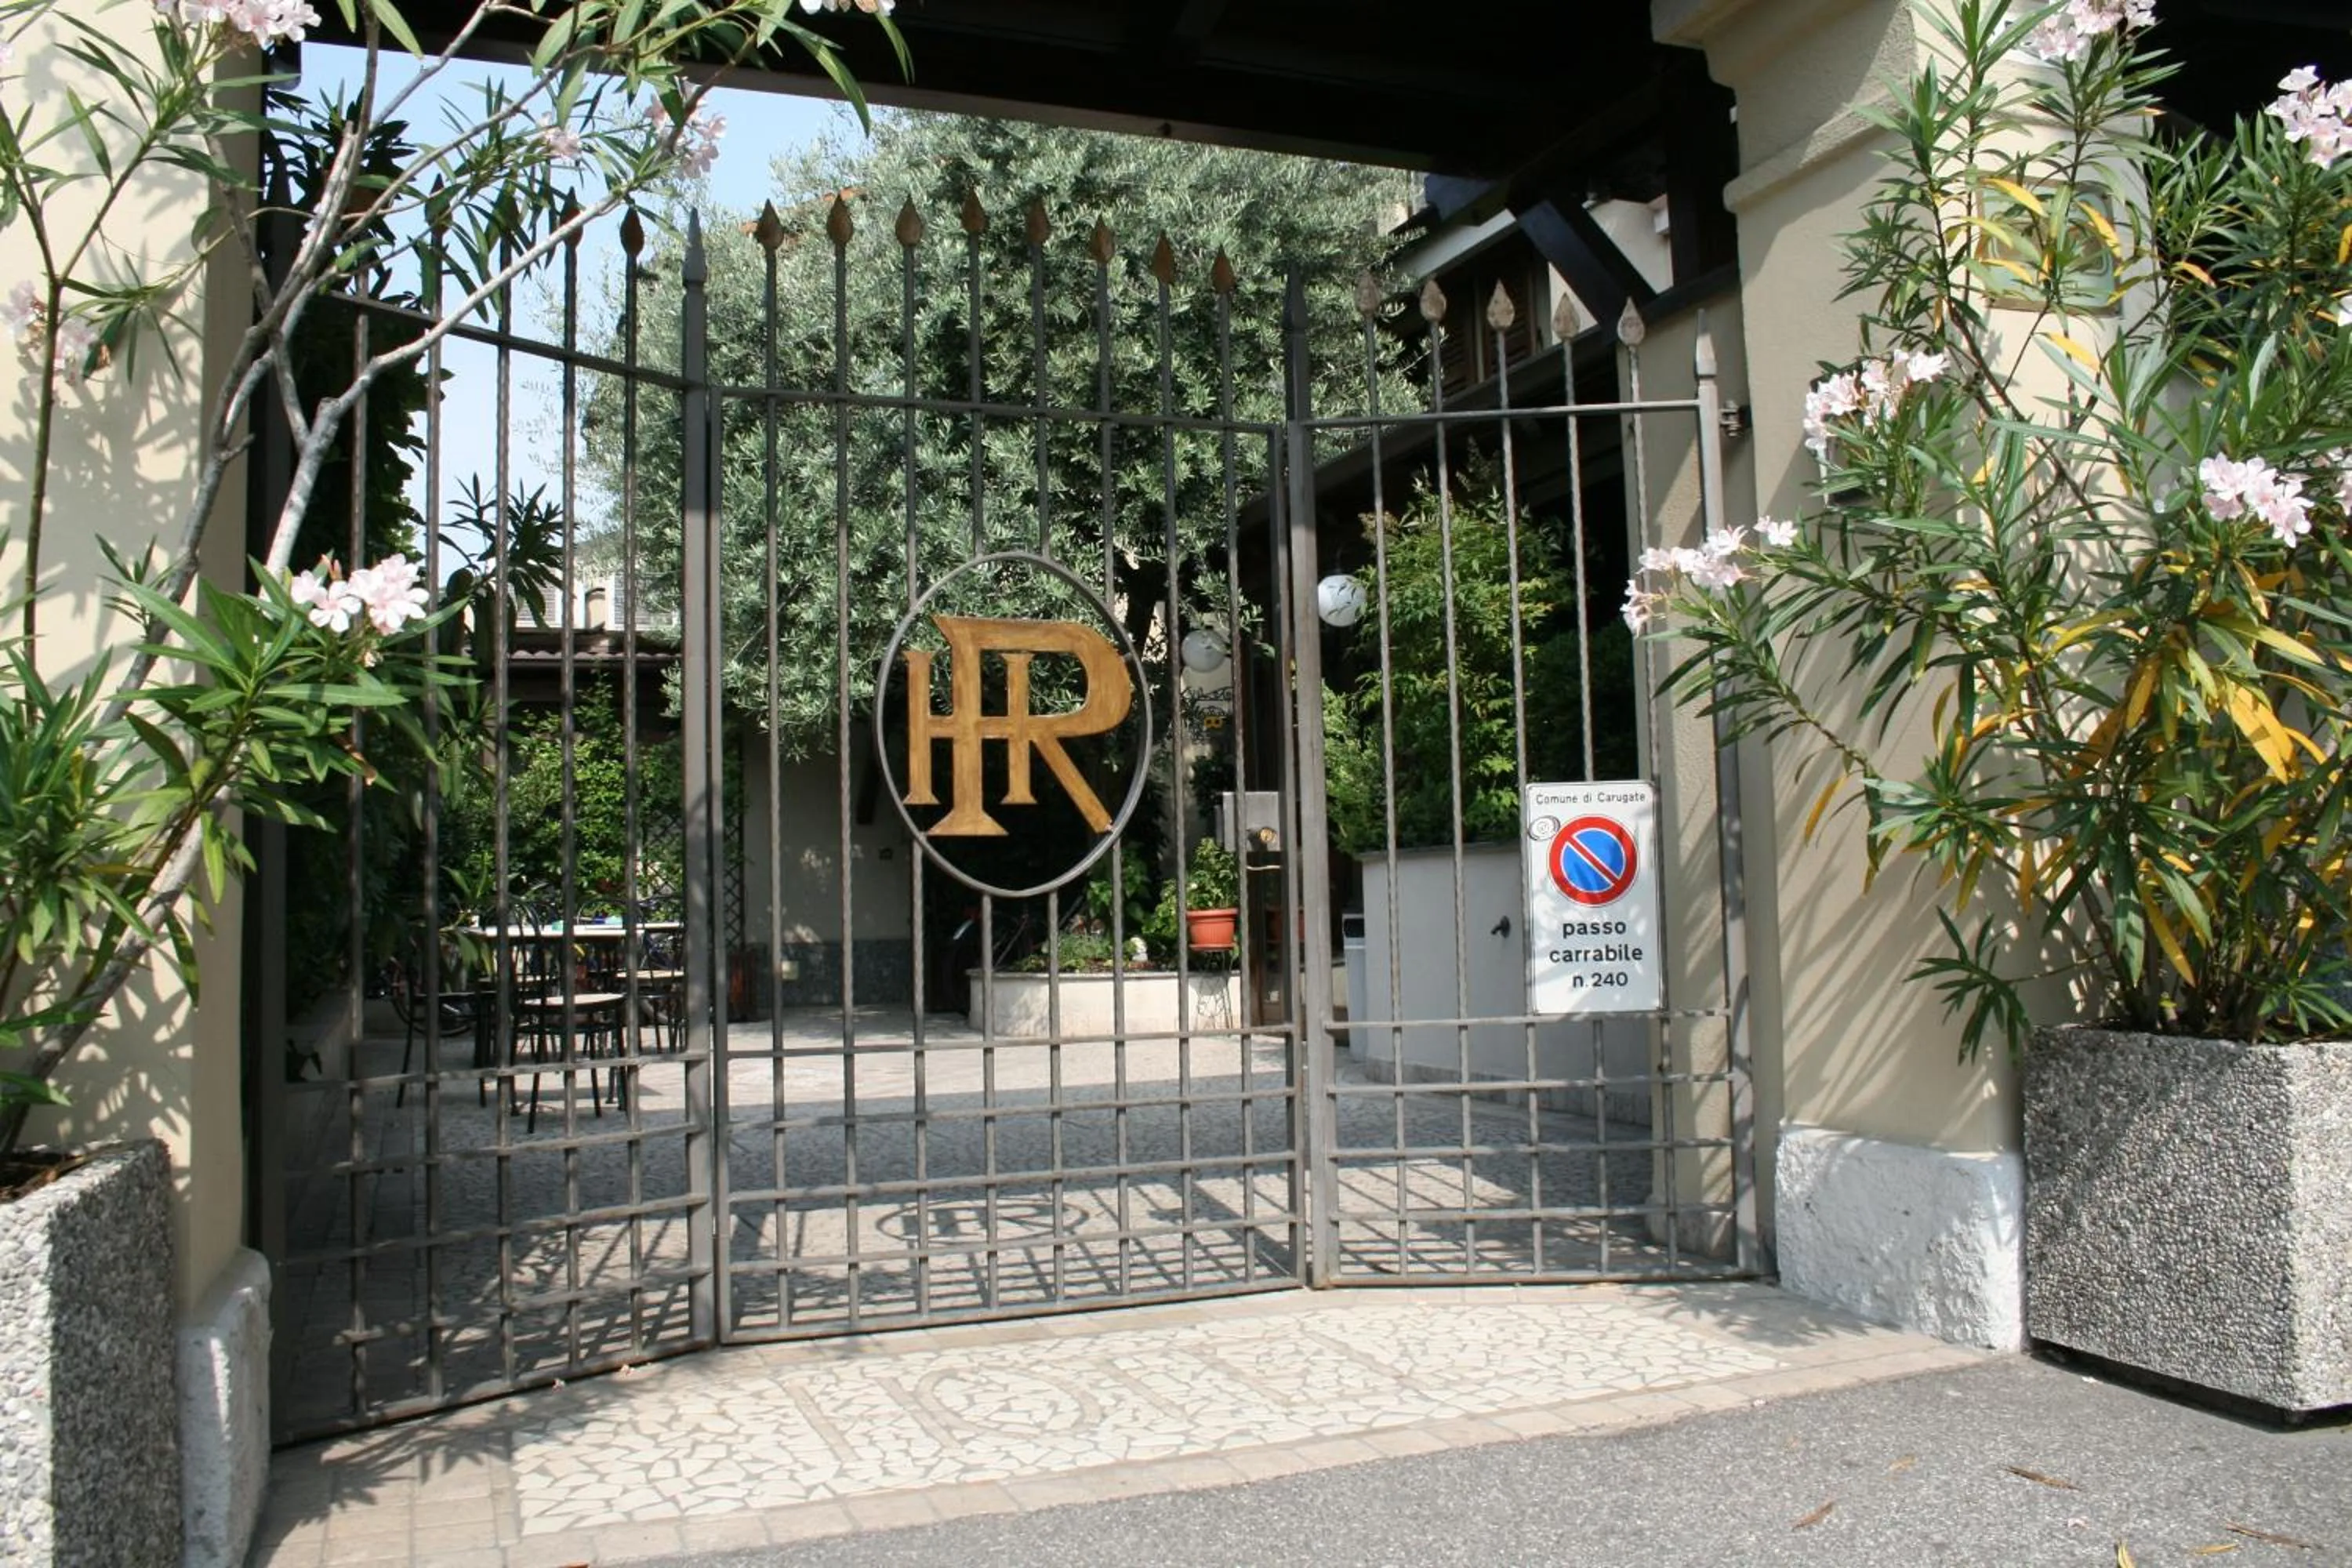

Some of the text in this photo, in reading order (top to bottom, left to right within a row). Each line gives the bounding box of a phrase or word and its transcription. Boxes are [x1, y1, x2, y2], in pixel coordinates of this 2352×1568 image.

[1535, 792, 1646, 804] Comune di Carugate
[1563, 921, 1627, 939] passo
[1549, 943, 1643, 963] carrabile
